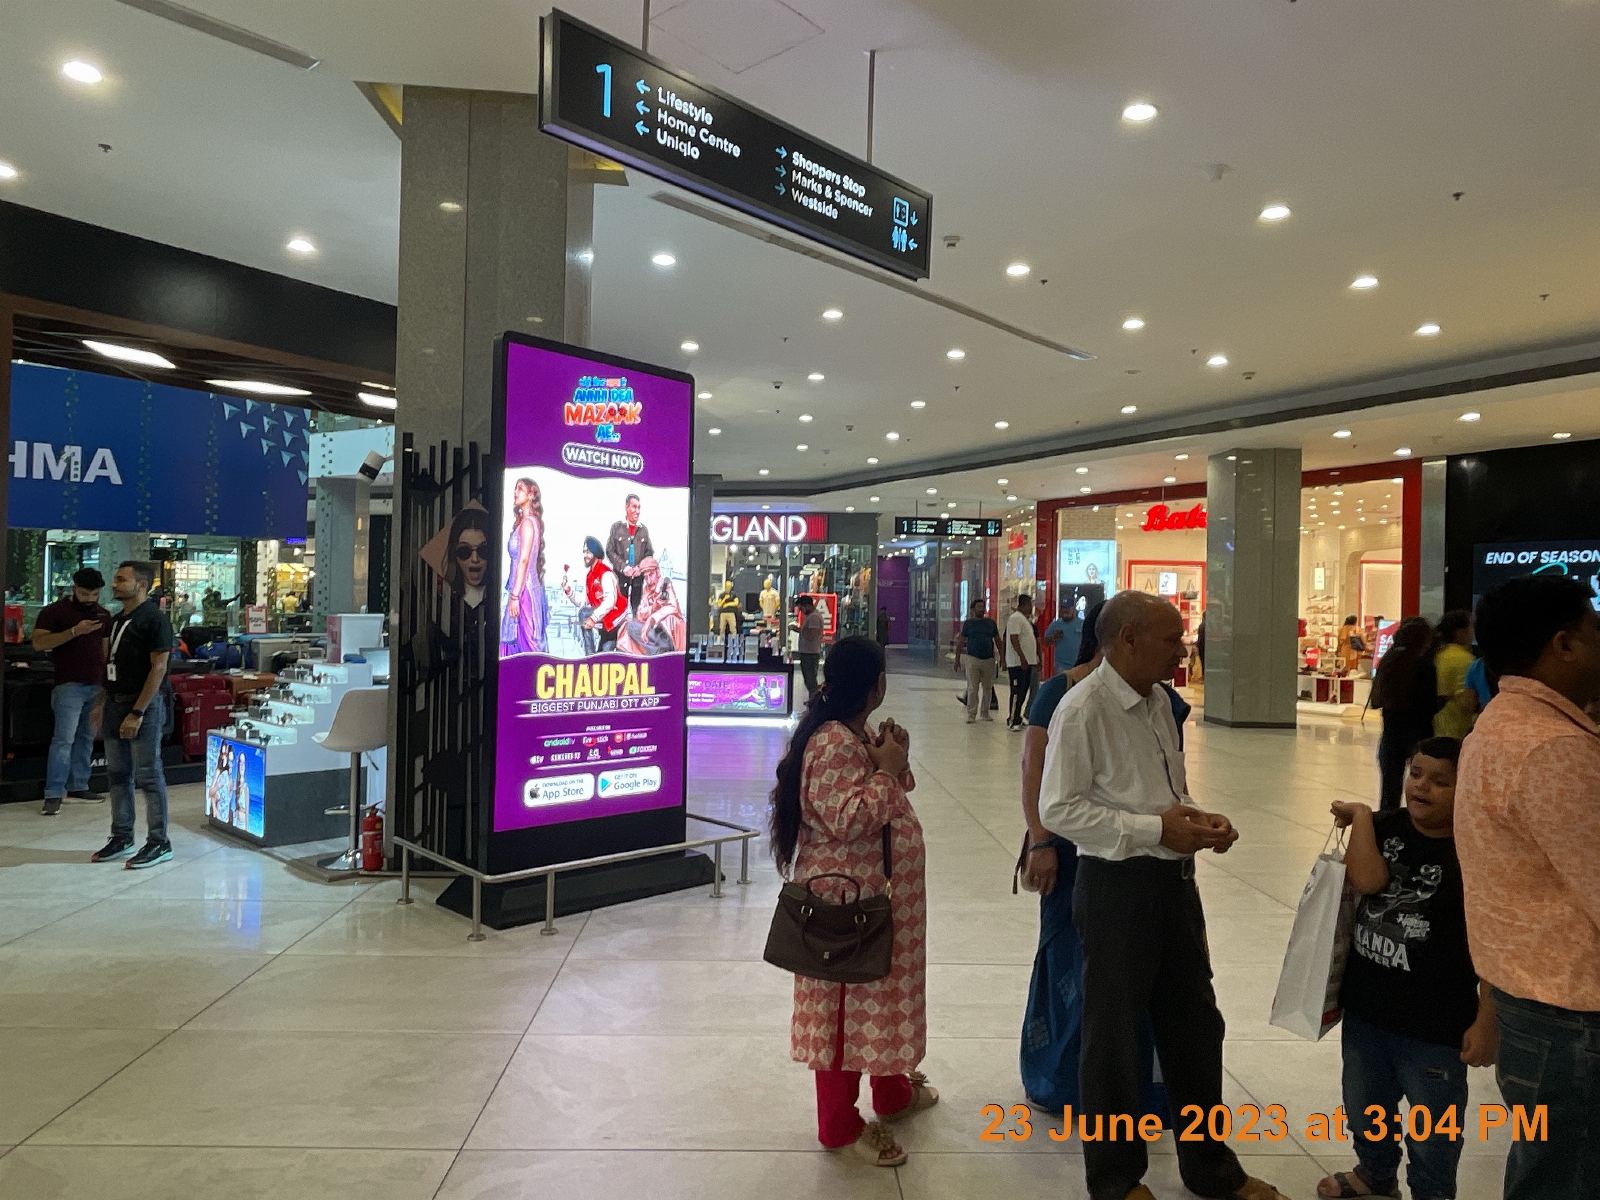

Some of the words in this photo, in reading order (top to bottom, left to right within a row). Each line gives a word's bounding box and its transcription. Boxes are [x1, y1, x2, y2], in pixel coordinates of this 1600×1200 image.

[596, 63, 612, 118] 1
[657, 86, 714, 126] Lifestyle
[656, 127, 700, 159] Uniqlo
[657, 107, 697, 138] Home
[699, 127, 741, 158] Centre
[792, 151, 841, 186] Shoppers
[842, 174, 866, 198] Stop
[791, 187, 839, 220] Westside
[792, 169, 823, 195] Marks
[824, 184, 833, 199] &
[834, 189, 874, 218] Spencer
[565, 447, 610, 466] WATCH
[611, 453, 641, 470] NOW
[711, 514, 808, 543] GLAND
[1485, 551, 1515, 565] END
[1517, 551, 1538, 564] OF
[536, 662, 656, 699] CHAUPAL
[530, 701, 575, 714] BIGGEST
[577, 699, 618, 711] PUNJABI
[620, 698, 639, 708] OTT
[640, 697, 660, 708] APP
[542, 789, 561, 801] App
[563, 786, 584, 797] Store
[613, 780, 641, 790] Google
[642, 778, 657, 788] Play
